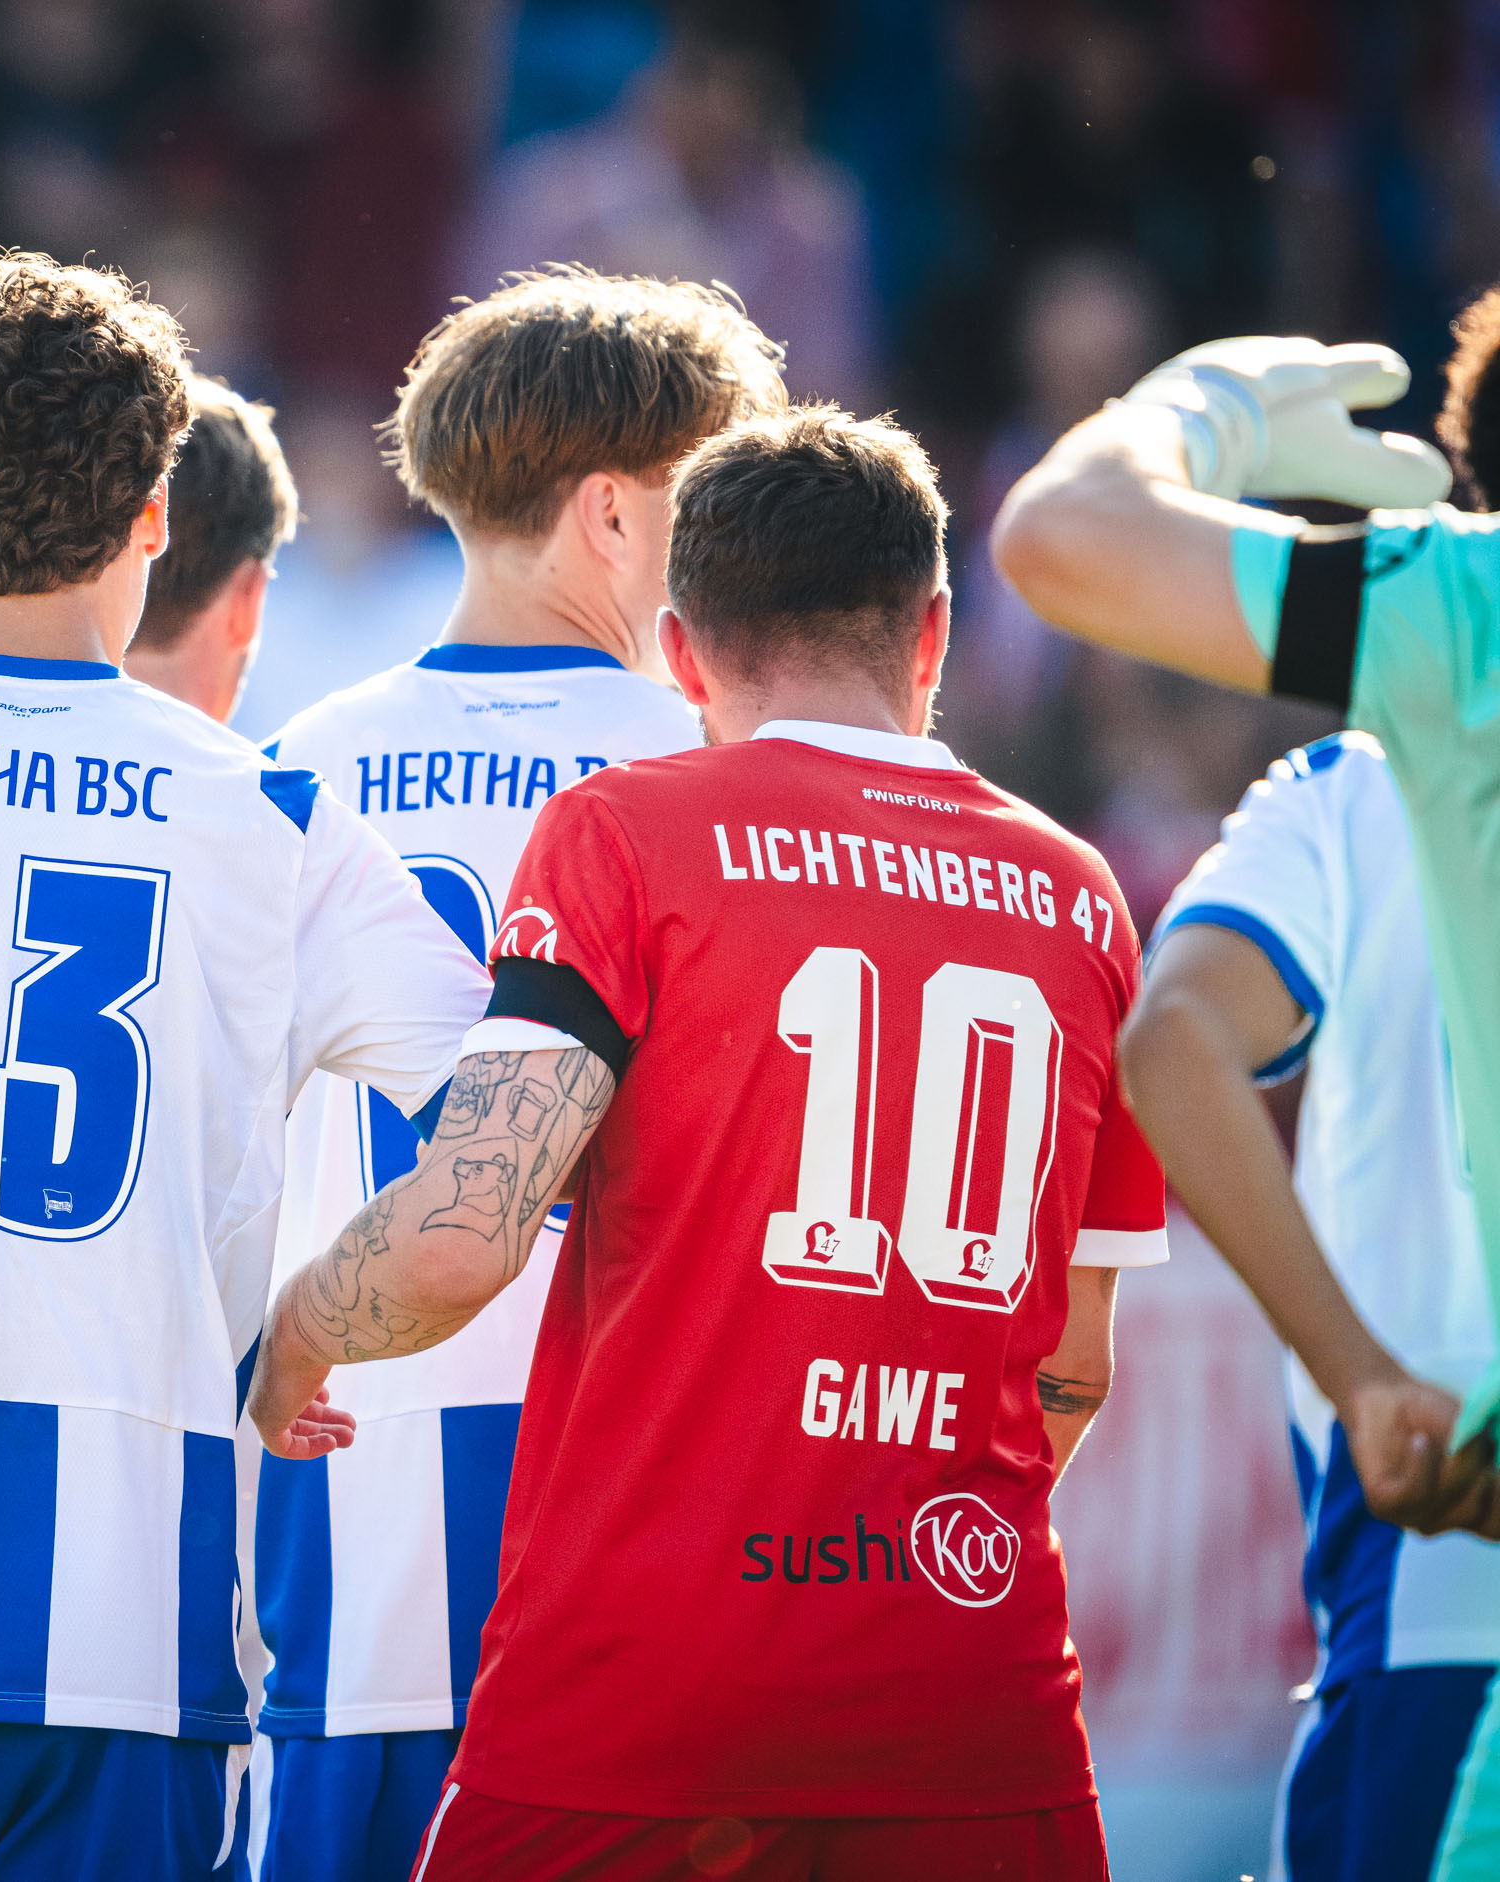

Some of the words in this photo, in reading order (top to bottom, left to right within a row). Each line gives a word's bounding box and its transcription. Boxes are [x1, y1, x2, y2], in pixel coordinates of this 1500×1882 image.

[75, 755, 173, 822] BSC
[357, 749, 557, 815] HERTHA
[862, 787, 961, 815] #WIRFÜR47
[713, 823, 1057, 929] LICHTENBERG
[1070, 886, 1114, 953] 47
[761, 945, 1065, 1315] 10
[801, 1357, 966, 1452] GAWE
[740, 1512, 912, 1584] sushi
[914, 1508, 1016, 1595] Koo
